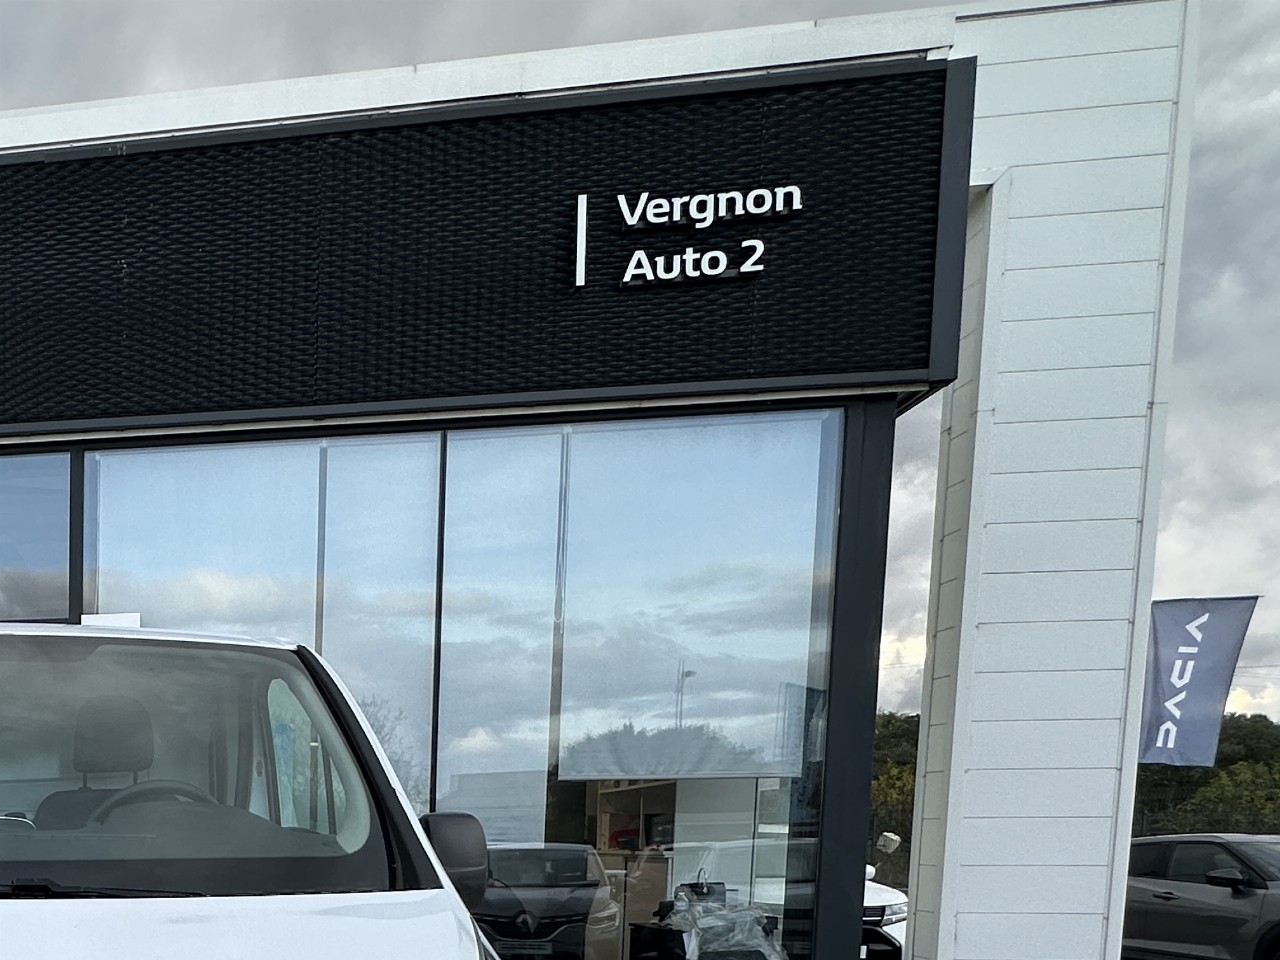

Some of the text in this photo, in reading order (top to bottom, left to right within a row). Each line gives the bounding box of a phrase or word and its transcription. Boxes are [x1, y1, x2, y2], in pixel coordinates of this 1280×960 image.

[617, 185, 803, 229] Vergnon
[622, 239, 765, 283] Auto 2
[1156, 612, 1210, 748] DACIA
